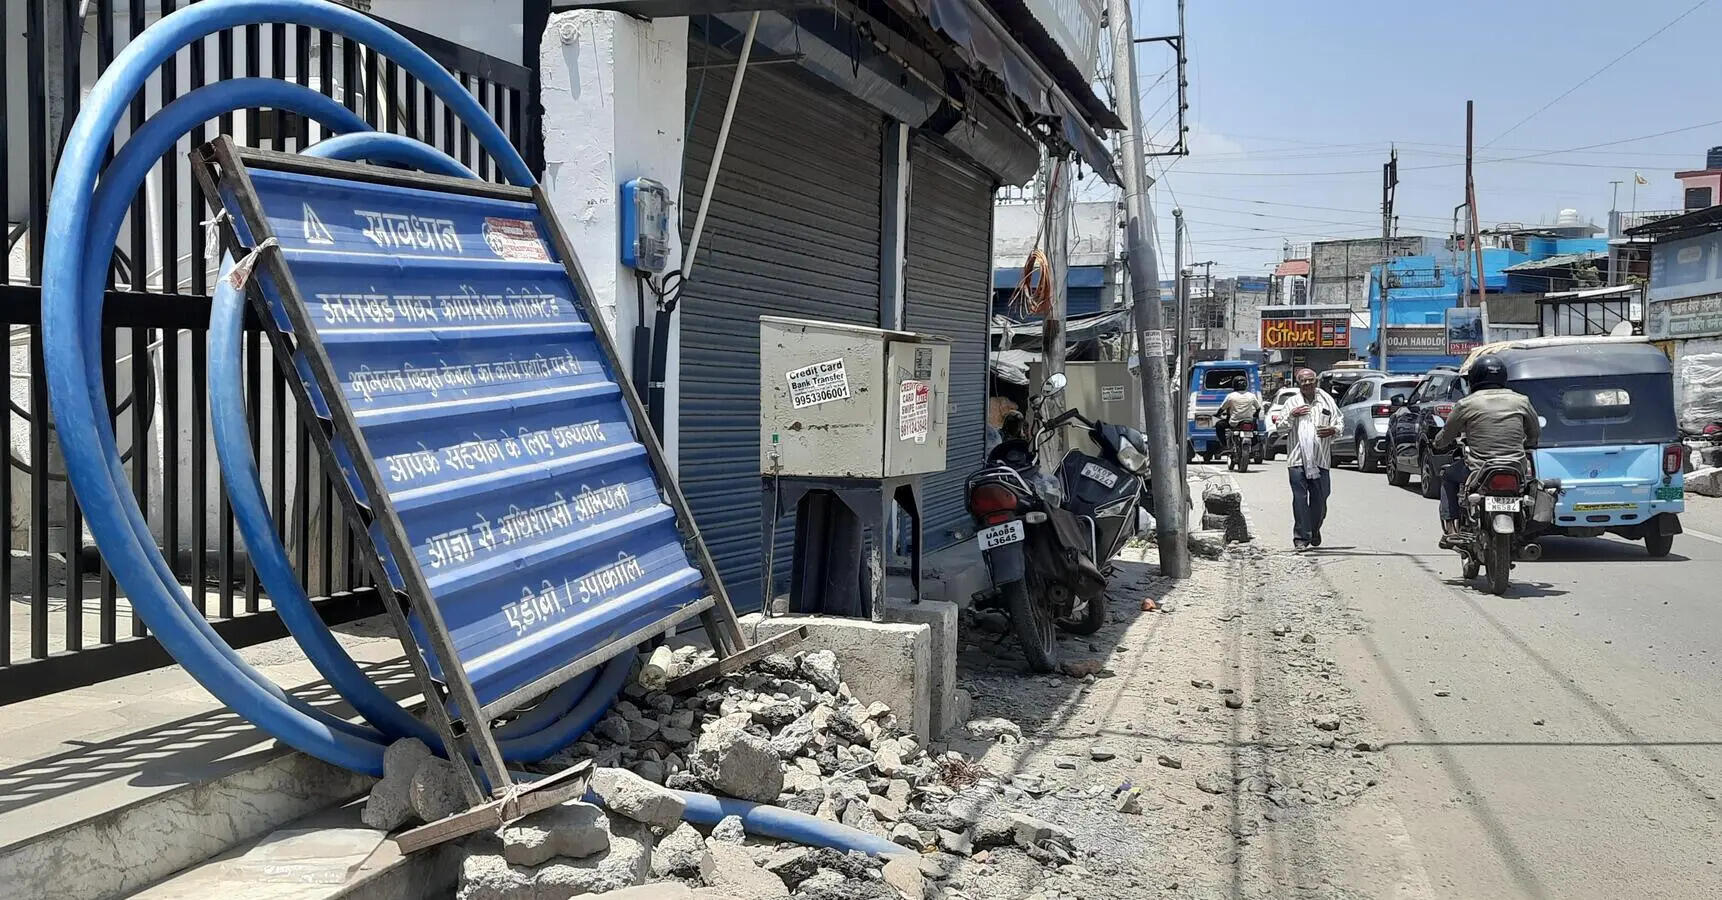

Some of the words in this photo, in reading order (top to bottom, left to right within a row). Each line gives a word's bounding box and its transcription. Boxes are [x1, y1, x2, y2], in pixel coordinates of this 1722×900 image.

[354, 209, 462, 254] सावधान
[393, 295, 438, 323] पावर
[506, 283, 560, 319] लिमिटेड
[1387, 336, 1408, 346] OOJA
[1410, 336, 1446, 346] HANDLOO
[348, 364, 407, 402] भूमिगत
[404, 362, 443, 398] विद्युत
[474, 363, 494, 384] का
[492, 353, 521, 380] कार्य
[549, 356, 569, 375] पर
[790, 366, 818, 380] Credit
[820, 361, 843, 373] Card
[791, 380, 811, 390] Bank
[812, 373, 844, 385] Transfer
[794, 386, 848, 406] 9953306001
[903, 392, 915, 403] CARD
[386, 441, 440, 482] आपके
[439, 432, 505, 471] सहयोग
[500, 429, 521, 458] के
[518, 426, 554, 456] लिए
[551, 419, 606, 448] धन्यवाद
[425, 527, 475, 568] आज्ञा
[472, 512, 496, 552] से
[497, 491, 573, 545] अधिशासी
[987, 533, 1018, 547] L3645
